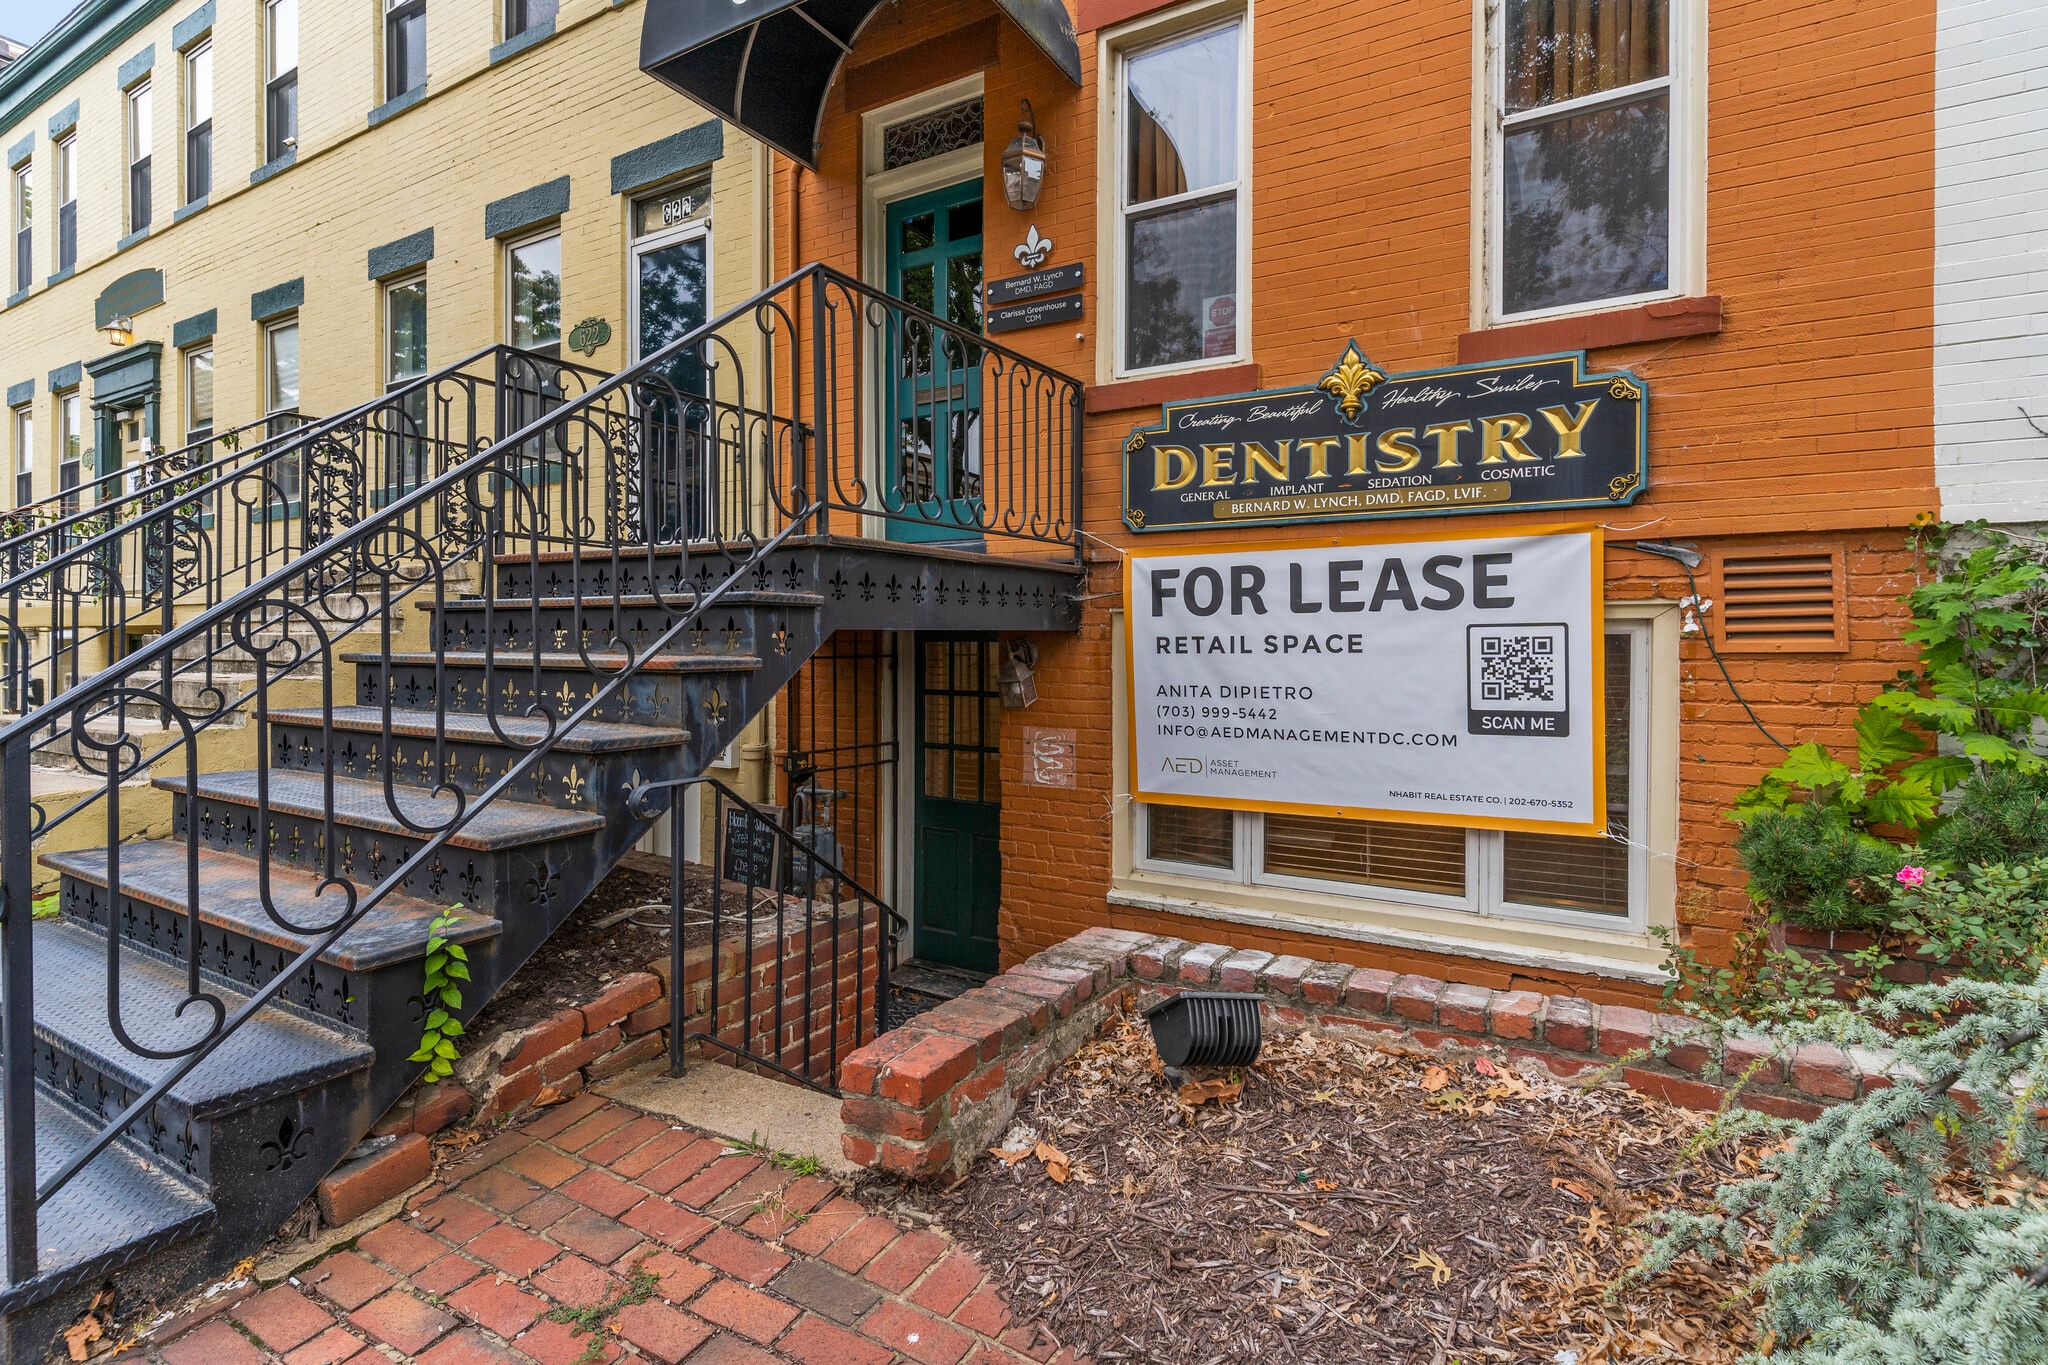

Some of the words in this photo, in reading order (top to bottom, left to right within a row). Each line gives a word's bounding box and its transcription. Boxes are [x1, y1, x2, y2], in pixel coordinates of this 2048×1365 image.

[1005, 278, 1032, 289] Bernard
[1043, 270, 1064, 281] Lynch
[1014, 286, 1033, 295] DMD,
[1033, 281, 1054, 292] FAGD
[1000, 309, 1026, 319] Clarissa
[1026, 301, 1067, 315] Greenhouse
[1025, 314, 1042, 323] CDM
[1210, 306, 1235, 317] STOP
[579, 325, 599, 347] 622
[1178, 411, 1242, 430] Creating
[1246, 399, 1324, 423] Beautiful
[1381, 386, 1461, 410] Healthy
[1467, 373, 1560, 399] Smiles
[1150, 397, 1602, 492] DENTISTRY
[1180, 490, 1231, 503] GENERAL
[1270, 482, 1325, 497] IMPLANT
[1367, 474, 1433, 489] SEDATION
[1480, 465, 1556, 481] COSMETIC
[1231, 499, 1291, 514] BERNARD
[1294, 498, 1310, 510] W.
[1313, 495, 1362, 509] LYNCH,
[1365, 493, 1404, 506] DMD,
[1408, 489, 1450, 503] FAGD,
[1454, 486, 1487, 500] LVIF.
[1151, 565, 1269, 617] FOR
[1289, 552, 1515, 614] LEASE
[1156, 635, 1252, 655] RETAIL
[1263, 633, 1363, 654] SPACE
[1156, 684, 1212, 698] ANITA
[1219, 685, 1313, 700] DIPIETRO
[1156, 705, 1196, 719] (703)
[1201, 706, 1277, 721] 999-5442
[1481, 716, 1526, 731] SCAN
[1530, 717, 1556, 732] ME
[1157, 724, 1458, 748] INFO@AEDMANAGEMENTDC.COM
[1161, 756, 1204, 774] AED
[1210, 759, 1240, 768] ASSET
[1210, 768, 1277, 779] MANAGEMENT
[1389, 790, 1423, 800] NHABIT
[1424, 792, 1448, 801] REAL
[1449, 793, 1484, 804] ESTATE
[1486, 796, 1503, 805] CO.
[1509, 797, 1574, 809] 202-670-5352
